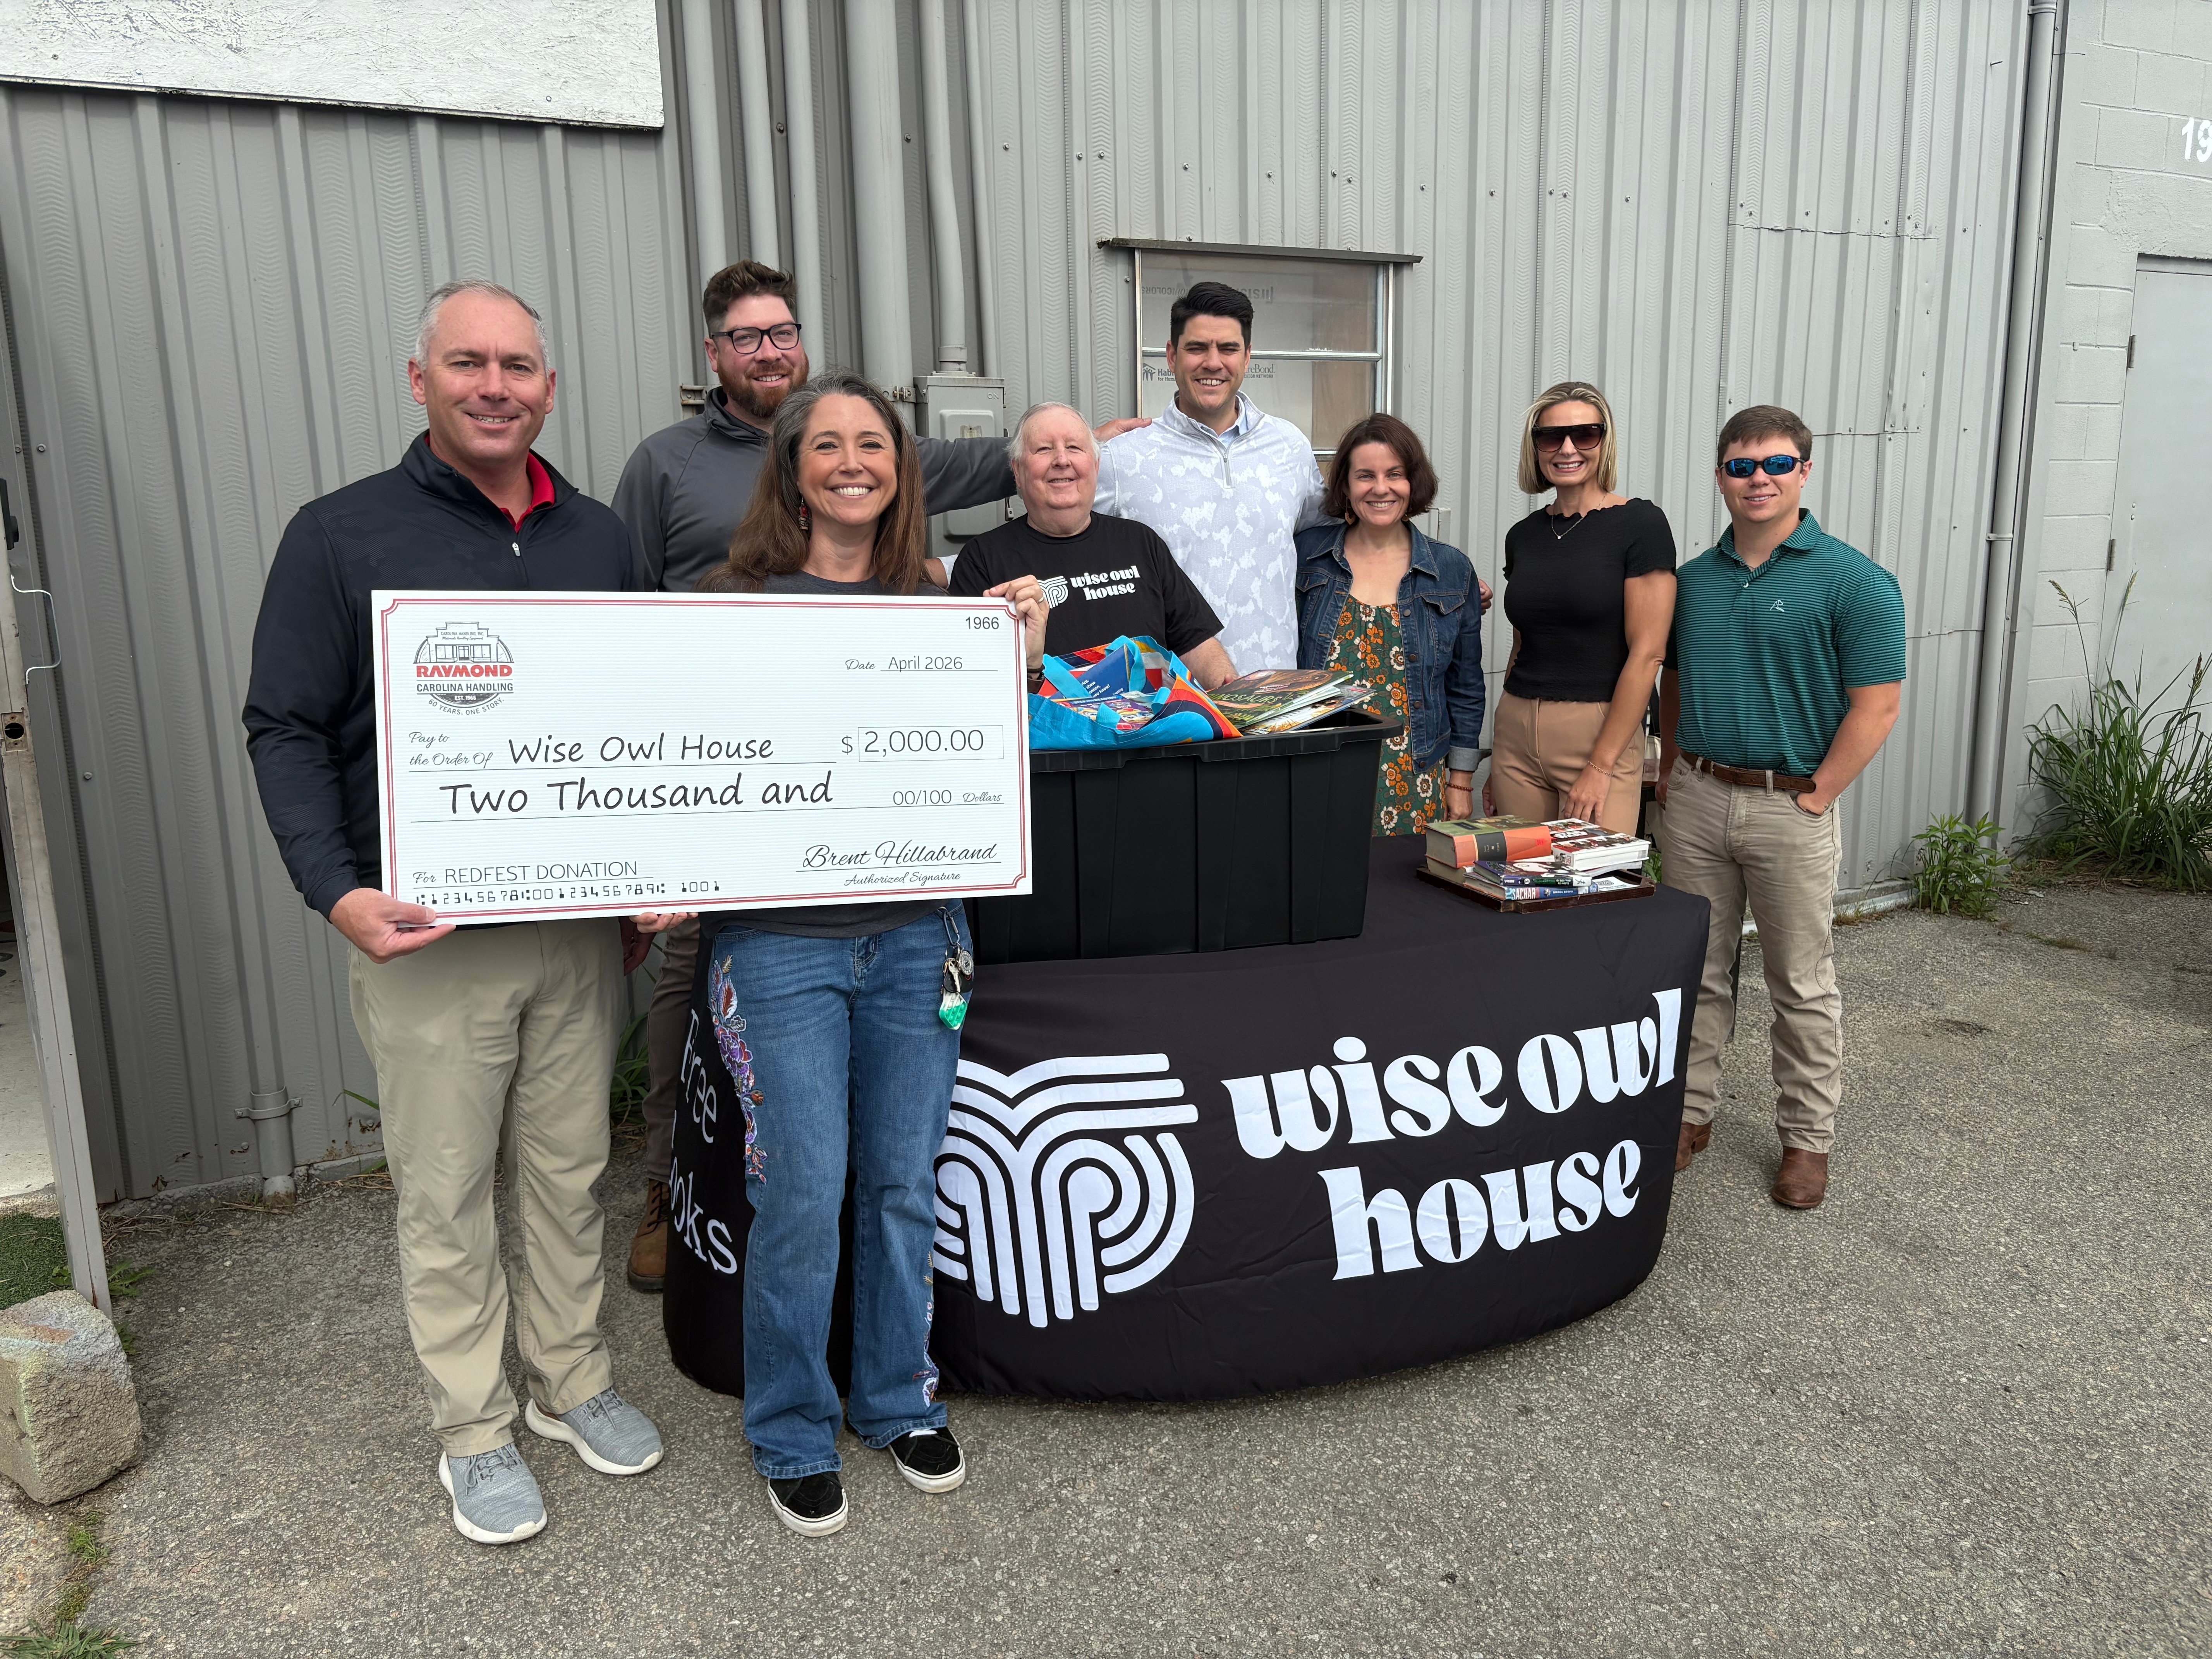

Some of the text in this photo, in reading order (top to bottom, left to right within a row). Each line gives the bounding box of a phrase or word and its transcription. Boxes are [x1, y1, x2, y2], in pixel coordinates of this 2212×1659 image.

[2181, 117, 2212, 163] 19
[1070, 565, 1141, 588] wise owl
[1083, 583, 1136, 601] house
[965, 617, 1000, 630] 1966
[416, 665, 512, 677] RAYMOND
[845, 655, 963, 672] Date April 2026
[417, 683, 513, 692] CAROLINA HANDLING
[428, 699, 438, 707] 60
[439, 704, 463, 715] YEARS.
[481, 697, 504, 712] STORY.
[409, 732, 450, 748] Pay to
[508, 732, 774, 764] Wise Owl House
[865, 730, 984, 757] 2,000.00
[409, 752, 493, 769] the Order Of
[439, 770, 833, 814] Two Thousand and
[893, 790, 1002, 805] 00/100 Dollars
[802, 839, 997, 868] Brent Hillabrand
[413, 860, 638, 884] For REDFEST DONATION
[843, 871, 961, 886] Authorized Signature
[1511, 887, 1536, 900] SACHAR
[681, 1008, 717, 1143] Free
[1220, 988, 1682, 1159] wise owl
[1317, 1139, 1642, 1281] house
